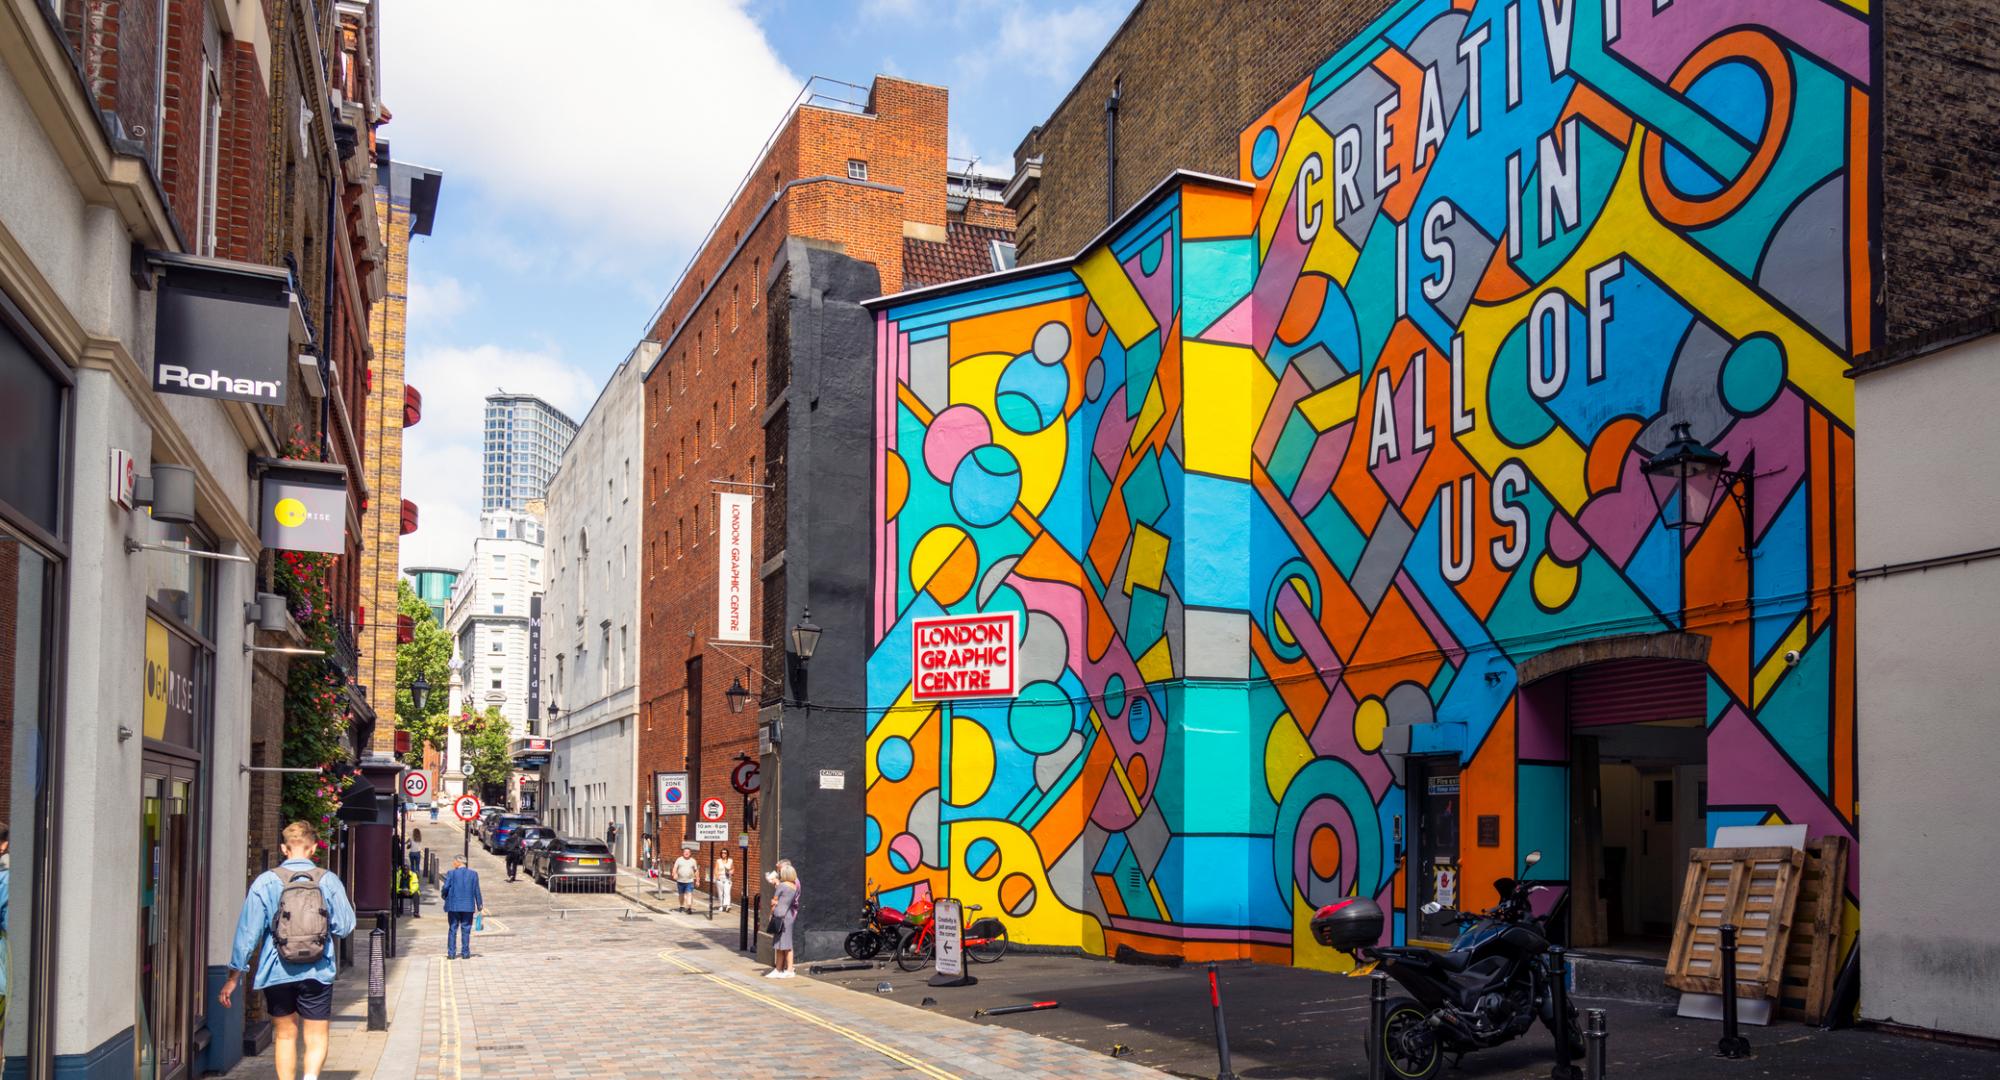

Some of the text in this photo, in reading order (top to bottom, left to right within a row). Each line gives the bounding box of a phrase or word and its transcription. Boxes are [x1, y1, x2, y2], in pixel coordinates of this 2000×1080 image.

[1296, 0, 1670, 244] CREATIV
[1397, 118, 1578, 319] IS IN
[1369, 256, 1623, 469] ALL OF
[1440, 463, 1527, 583] US
[730, 504, 740, 631] LONDON GRAPHIC CENTRE
[531, 617, 541, 699] Matilda
[920, 623, 1003, 647] LONDON
[920, 646, 1007, 669] GRAPHIC
[145, 656, 193, 714] OGARISE
[920, 670, 991, 691] CENTRE
[407, 780, 424, 789] 20
